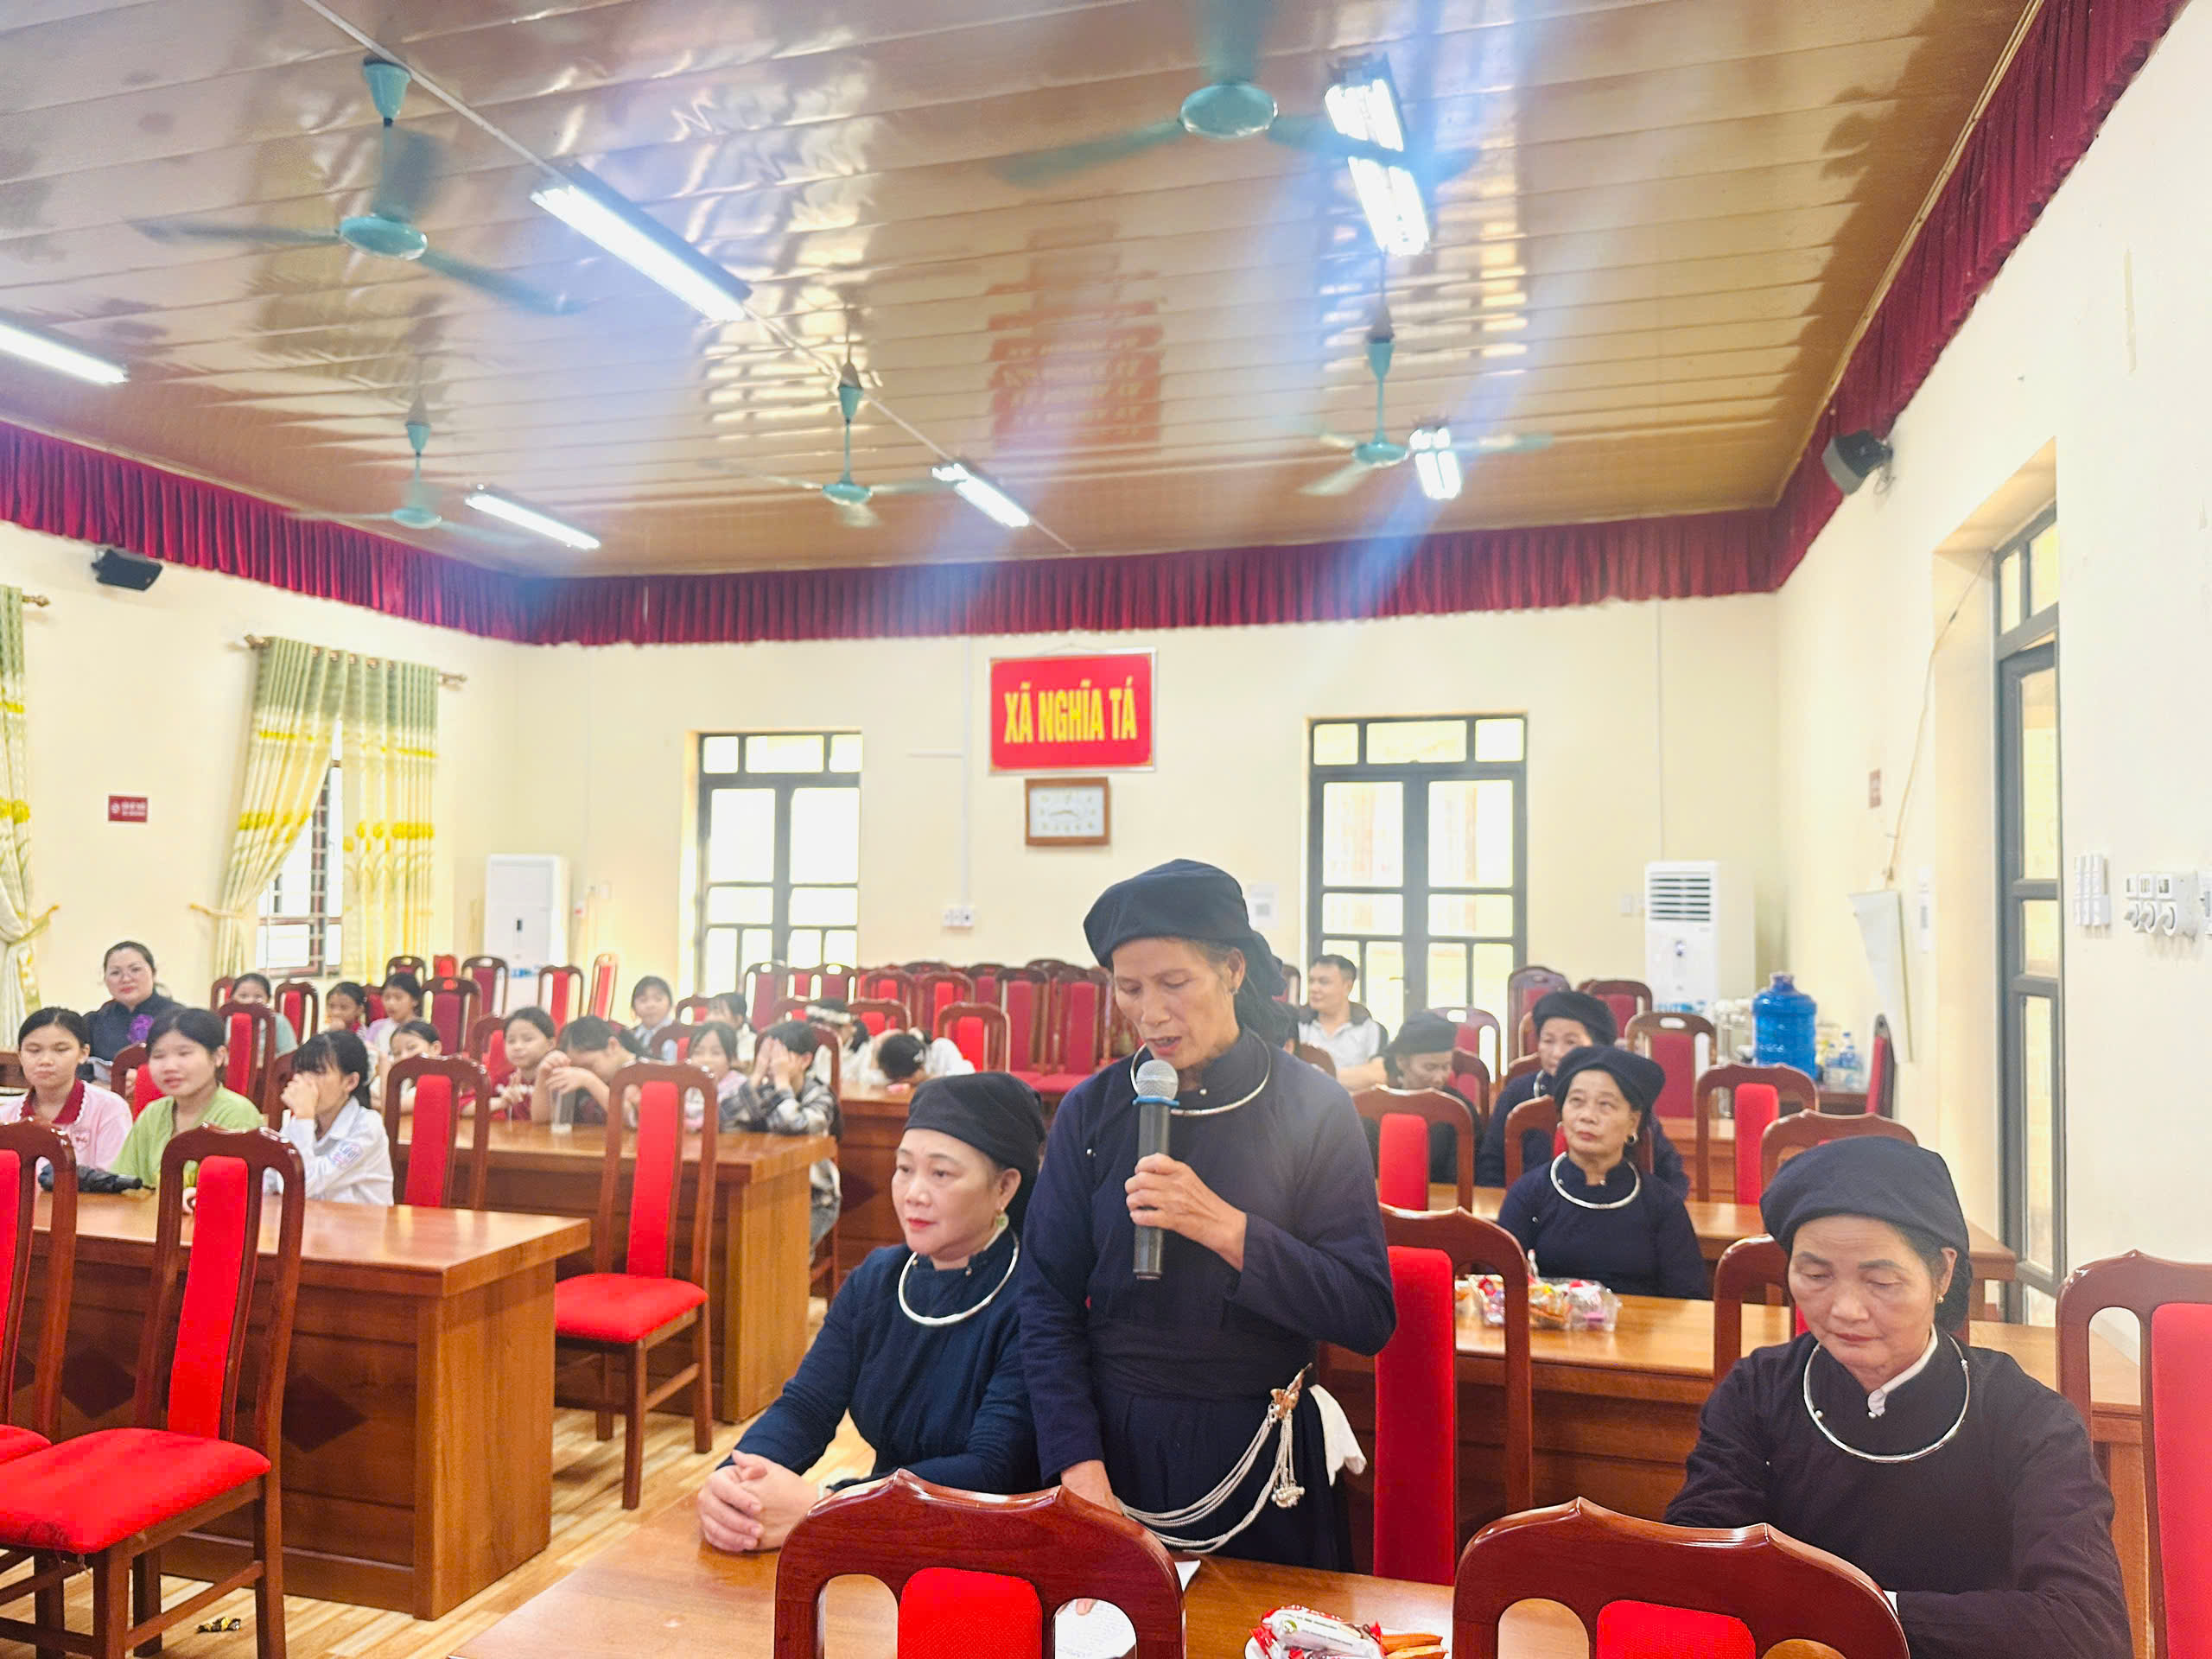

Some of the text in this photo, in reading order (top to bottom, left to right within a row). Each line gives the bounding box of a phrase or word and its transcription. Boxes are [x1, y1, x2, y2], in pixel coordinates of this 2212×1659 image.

[1004, 676, 1136, 743] XÃ NGHĨA TÁ
